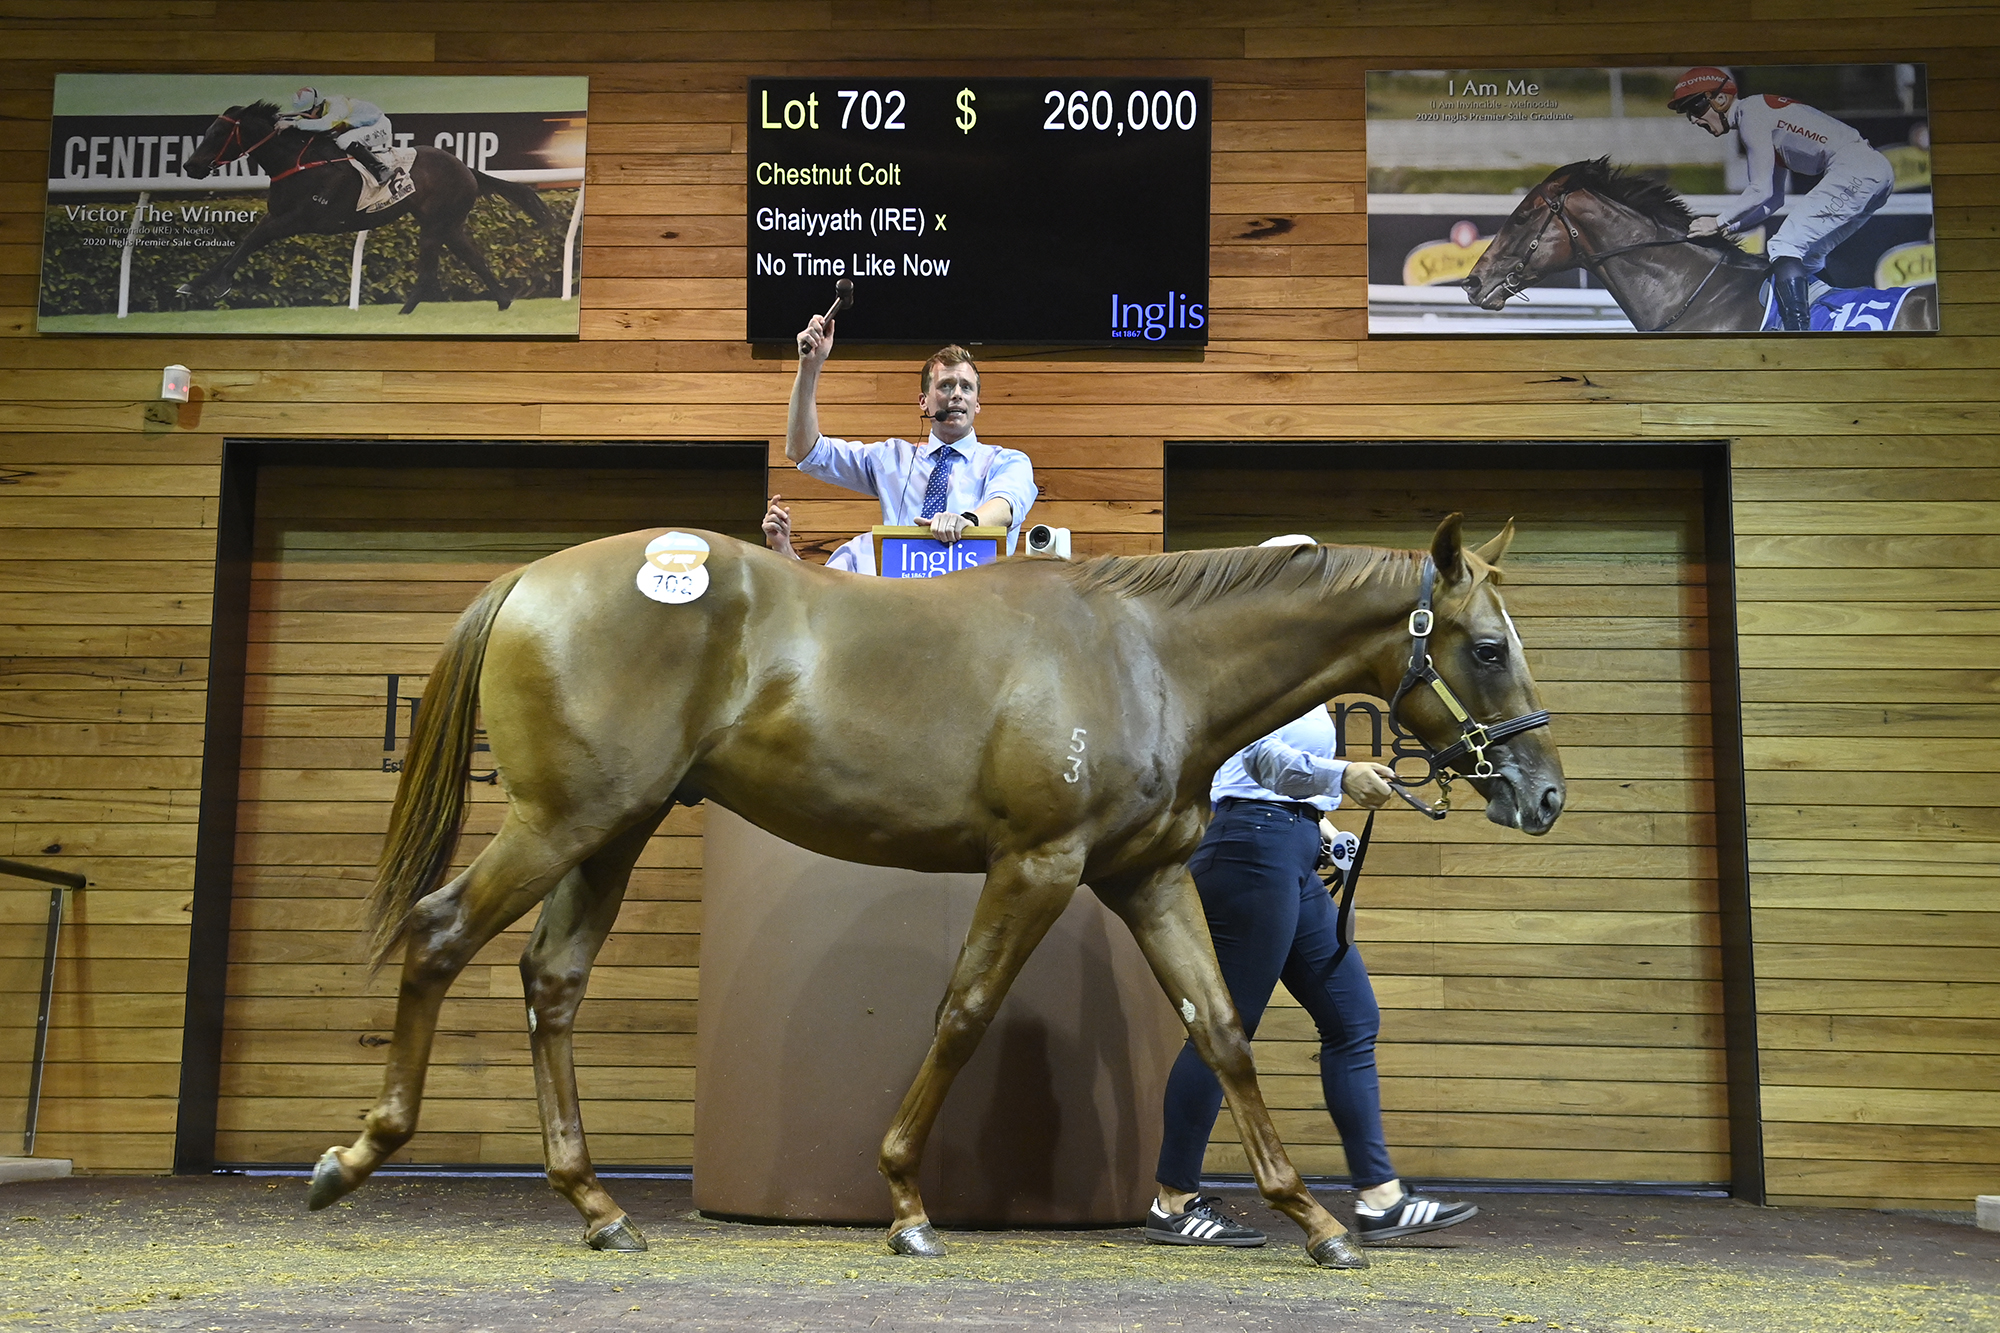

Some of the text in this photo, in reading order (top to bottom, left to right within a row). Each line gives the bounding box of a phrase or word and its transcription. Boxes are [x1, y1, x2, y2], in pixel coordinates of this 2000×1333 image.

[1449, 80, 1539, 96] I Am Me
[762, 87, 1197, 137] Lot 702 $ 260,000
[1439, 100, 1454, 109] Am
[1456, 100, 1501, 109] Invincible
[1416, 112, 1573, 123] 2020 Inglis Premier Sale Graduate
[756, 162, 901, 185] Chestnut Colt
[65, 204, 258, 223] Victor The Winner
[756, 207, 947, 237] Ghaiyyath (IRE) x
[105, 226, 150, 235] (Toronado
[152, 226, 173, 235] (IRE)
[182, 226, 214, 235] Noetic)
[83, 238, 236, 249] 2020 Inglis Premier Sale Graduate
[756, 253, 950, 276] No Time Like Now
[1112, 291, 1205, 341] Inglis
[1829, 300, 1890, 331] 15
[1112, 330, 1141, 338] Est 1867
[901, 542, 978, 578] Inglis
[653, 575, 692, 595] 702
[1069, 728, 1087, 753] 5
[1063, 755, 1082, 783] 3
[1346, 838, 1357, 862] 702
